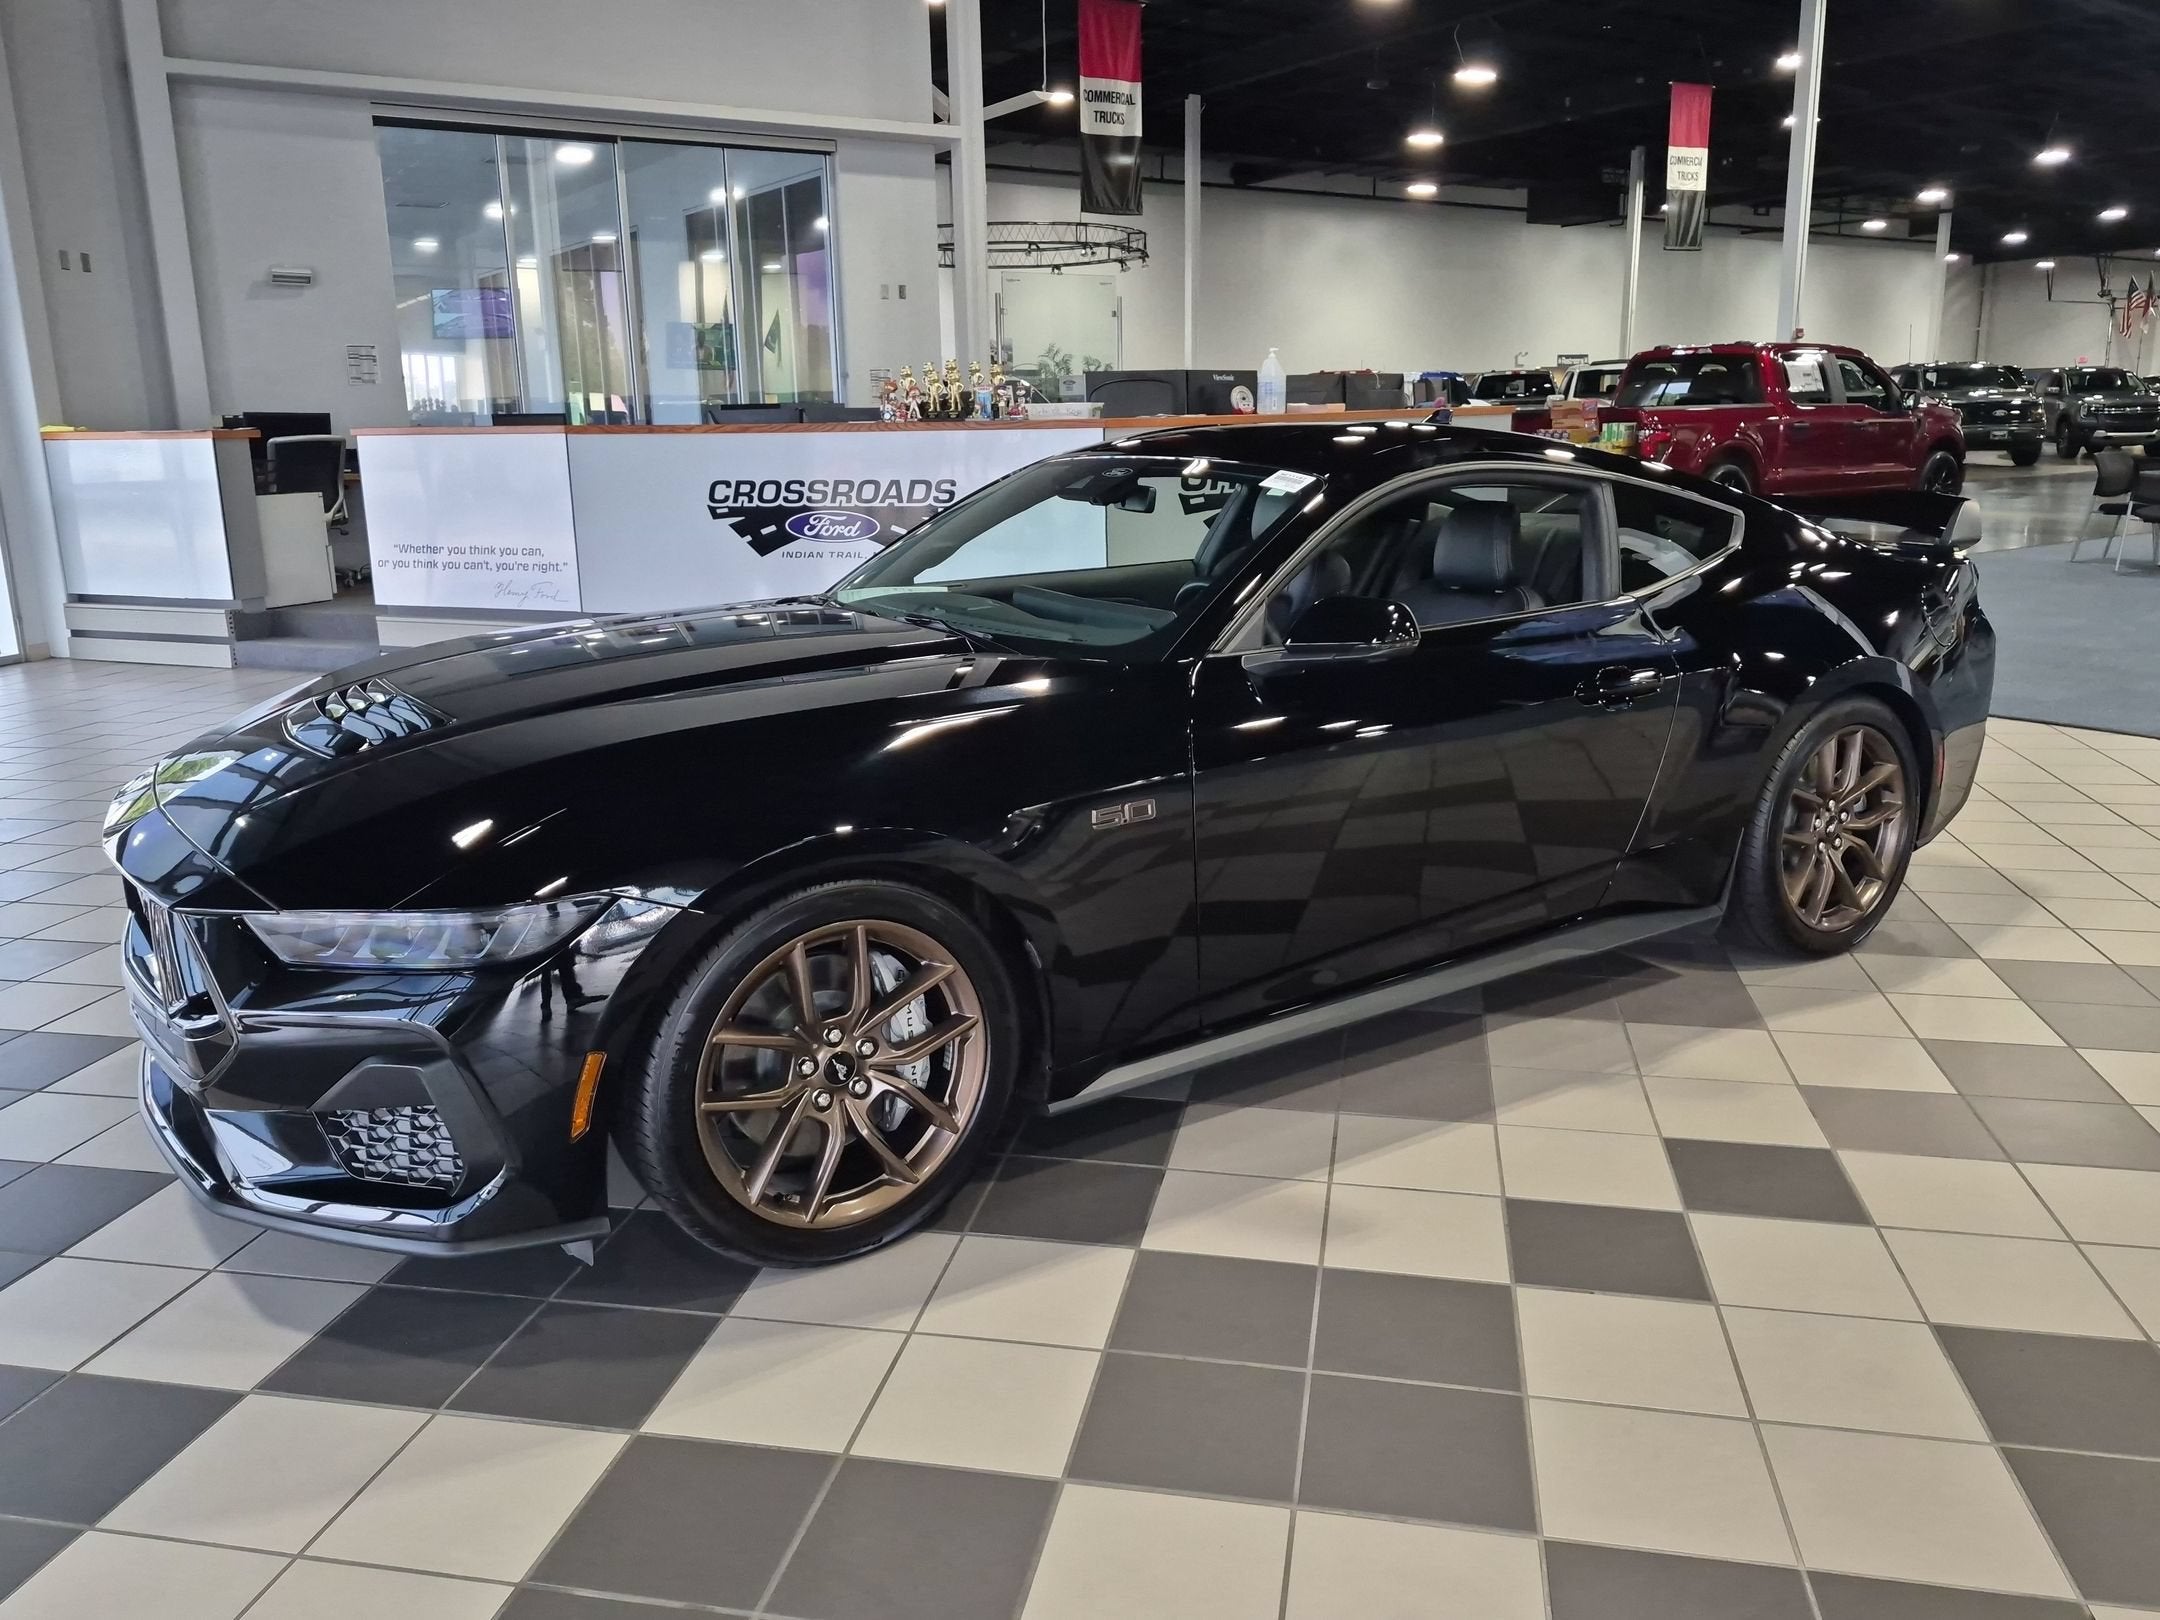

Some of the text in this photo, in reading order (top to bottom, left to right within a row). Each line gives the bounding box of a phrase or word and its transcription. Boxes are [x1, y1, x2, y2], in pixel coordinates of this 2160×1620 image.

[1093, 110, 1125, 125] TRUCKS
[708, 479, 956, 505] CROSSROADS
[803, 513, 862, 537] Ford
[393, 543, 544, 558] "Whether you think you can,
[781, 551, 824, 559] INDIAN
[828, 551, 868, 560] TRAIL,
[377, 559, 568, 574] or you think you can't, you're right."
[1091, 798, 1157, 830] 5.0
